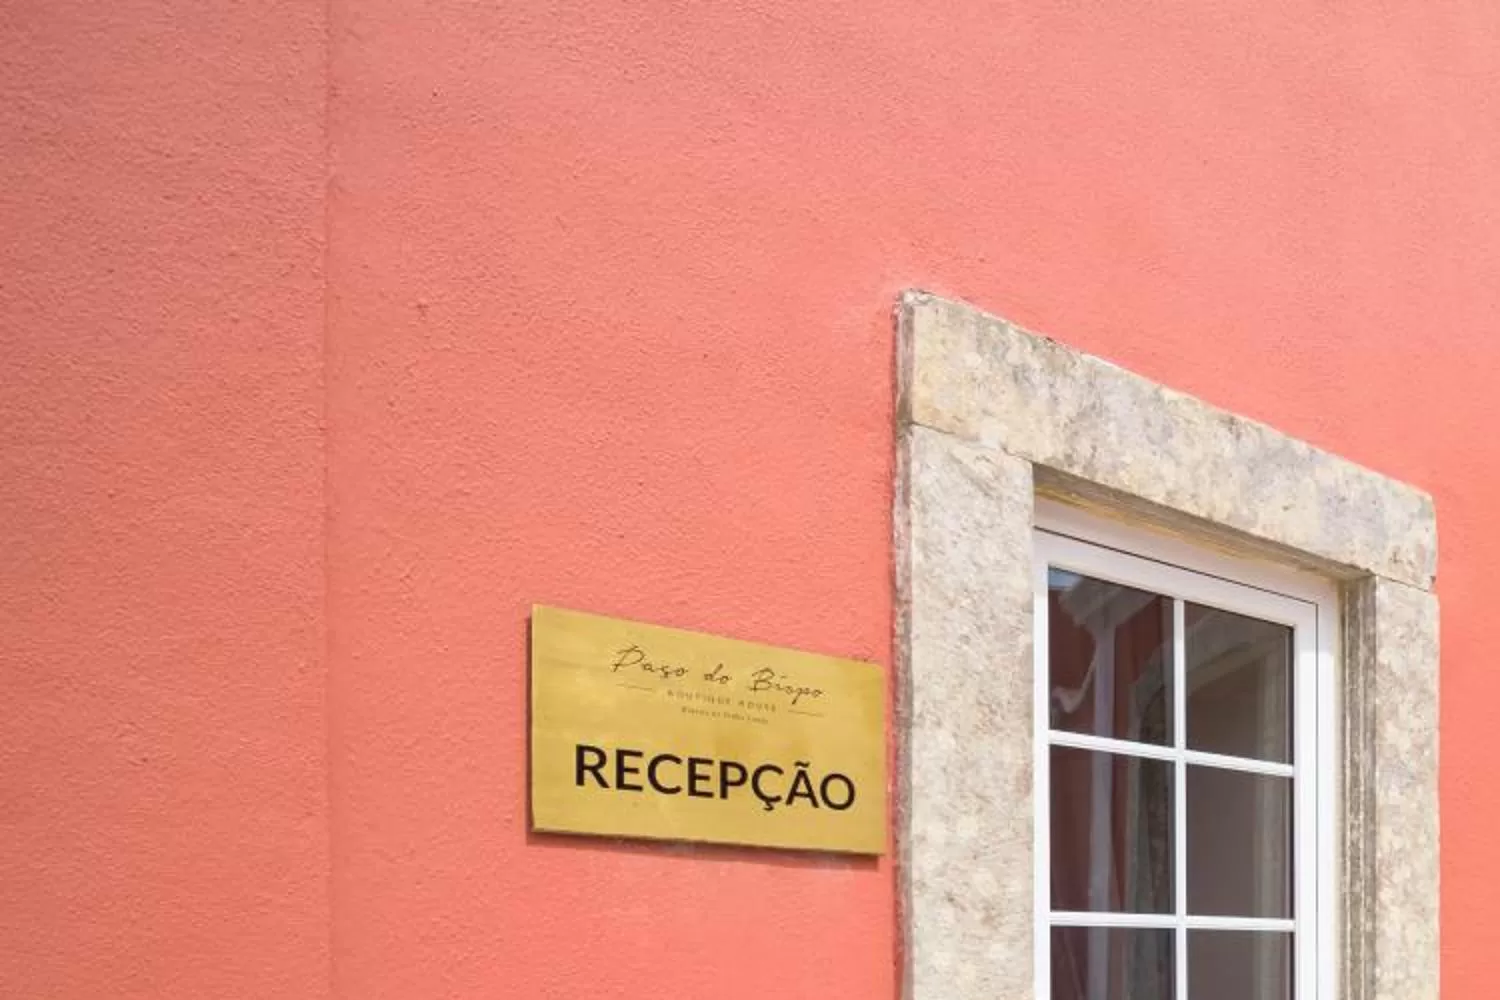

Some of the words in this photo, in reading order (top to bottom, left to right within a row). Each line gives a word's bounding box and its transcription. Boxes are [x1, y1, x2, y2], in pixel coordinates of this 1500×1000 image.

[611, 645, 688, 679] Paço
[704, 663, 732, 684] do
[748, 667, 825, 705] Bispo
[575, 744, 856, 811] RECEPÇÃO
